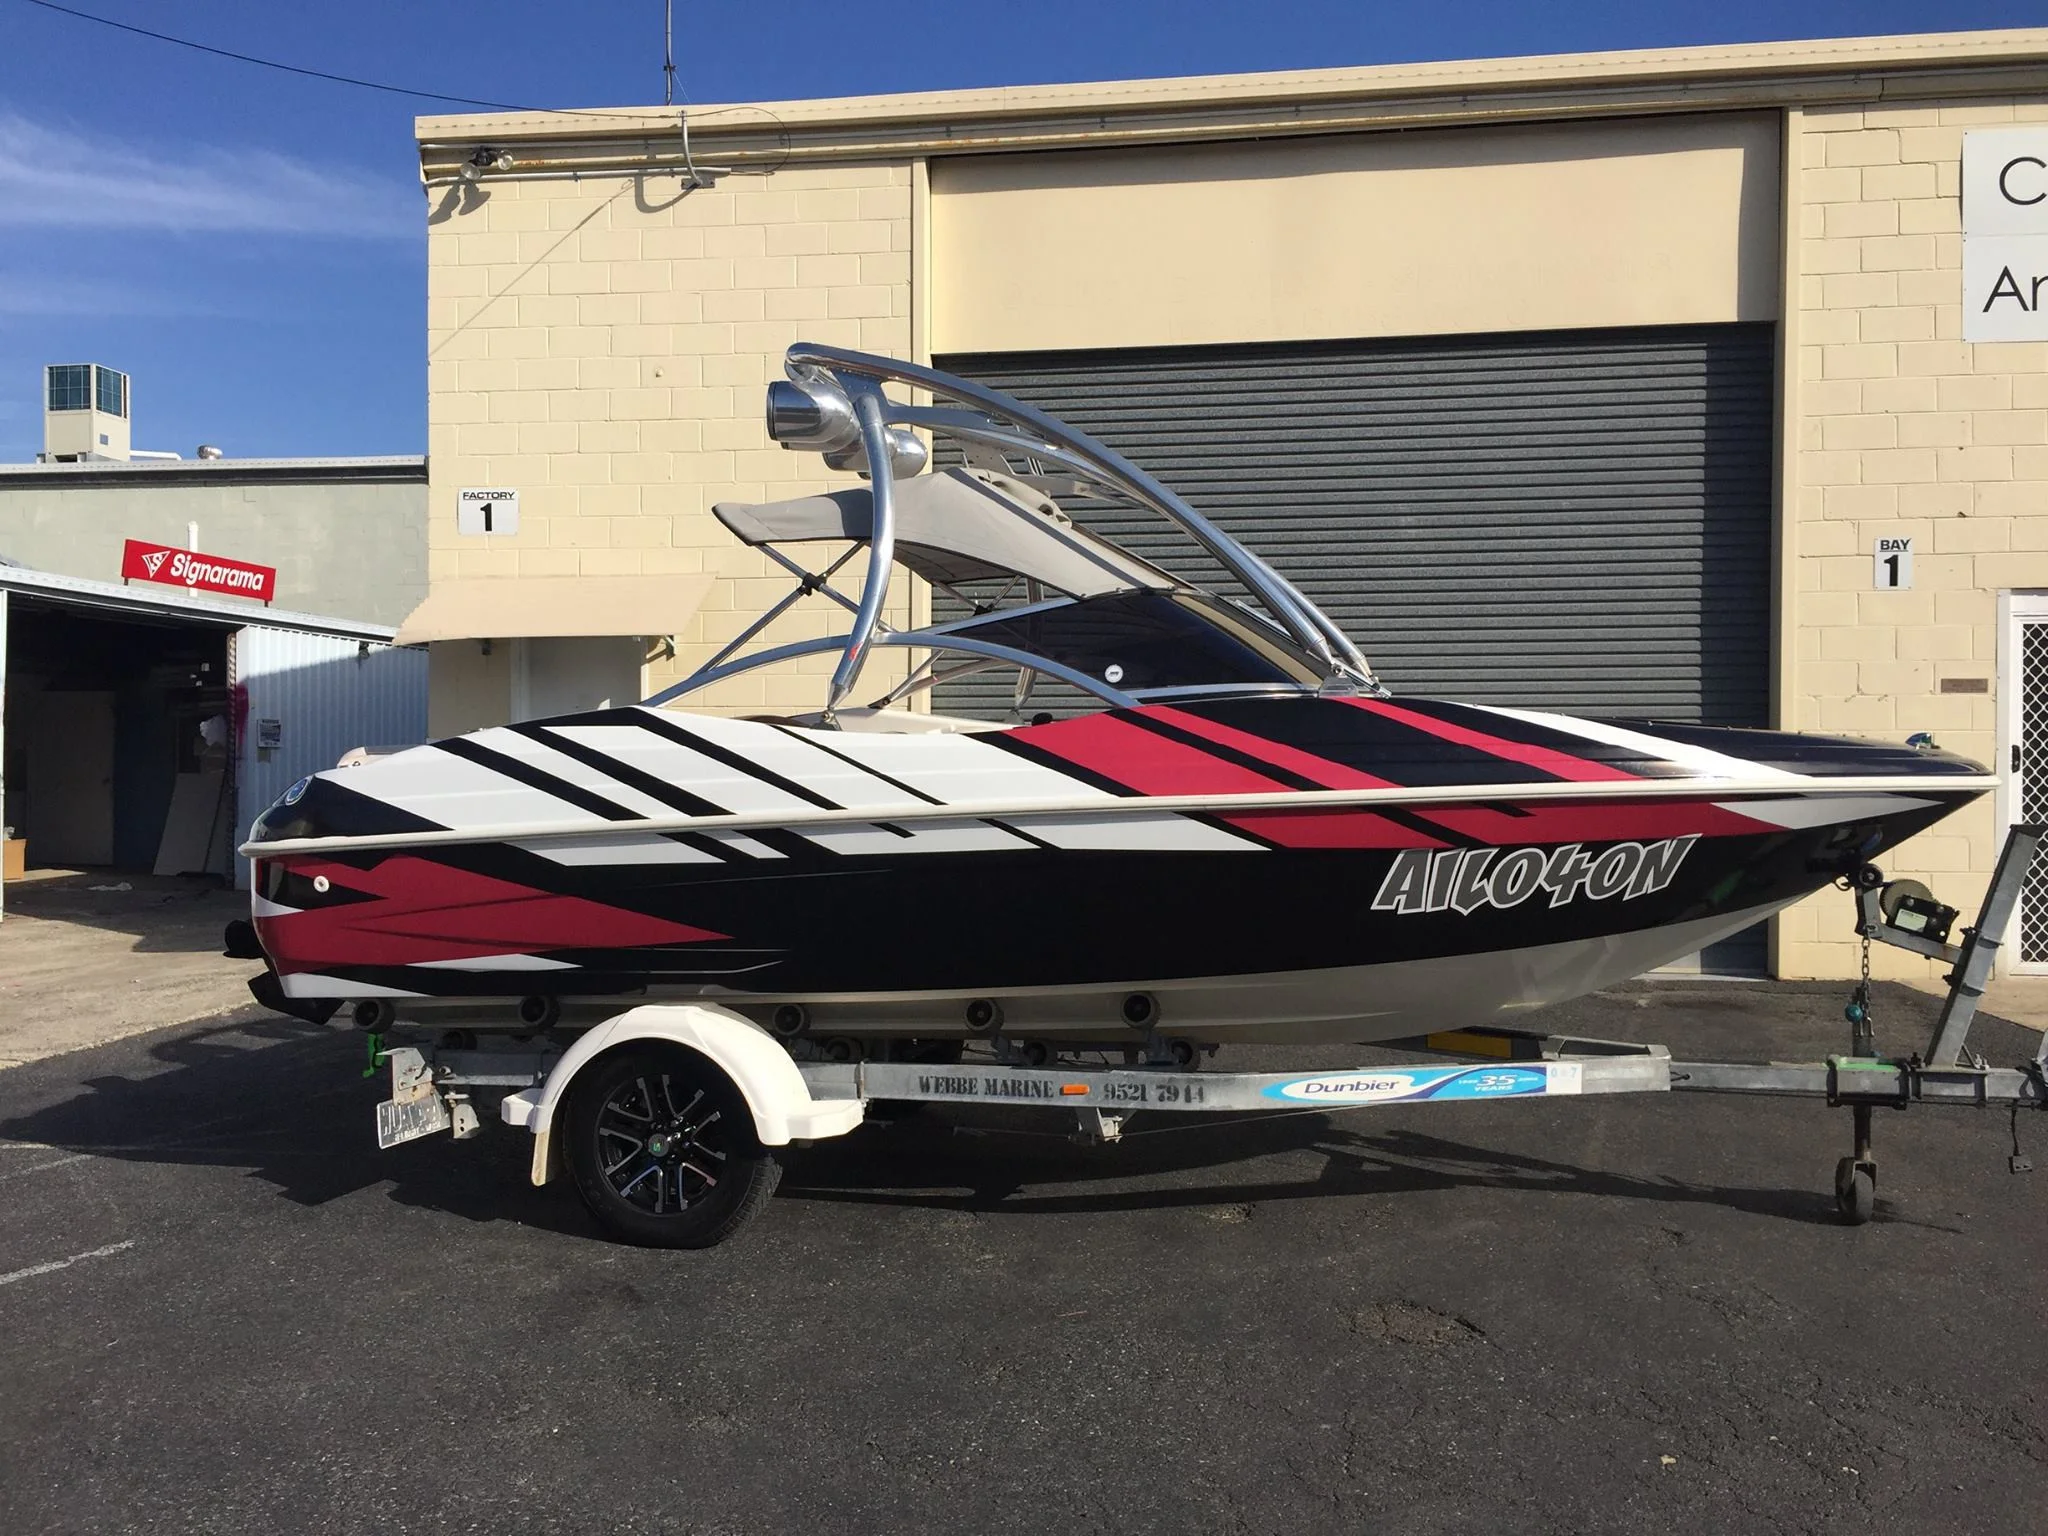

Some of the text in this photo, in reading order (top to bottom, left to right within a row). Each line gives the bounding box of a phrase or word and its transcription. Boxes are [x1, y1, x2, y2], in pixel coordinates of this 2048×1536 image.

[462, 491, 516, 500] FACTORY
[480, 502, 493, 532] 1
[1880, 538, 1911, 551] BAY
[170, 553, 264, 591] Signarama
[1883, 554, 1899, 587] 1
[919, 1075, 979, 1096] WEBBE
[984, 1077, 1055, 1098] MARINE
[1103, 1083, 1148, 1102] 9521
[1304, 1081, 1399, 1094] Dunbier
[1476, 1074, 1518, 1087] 35
